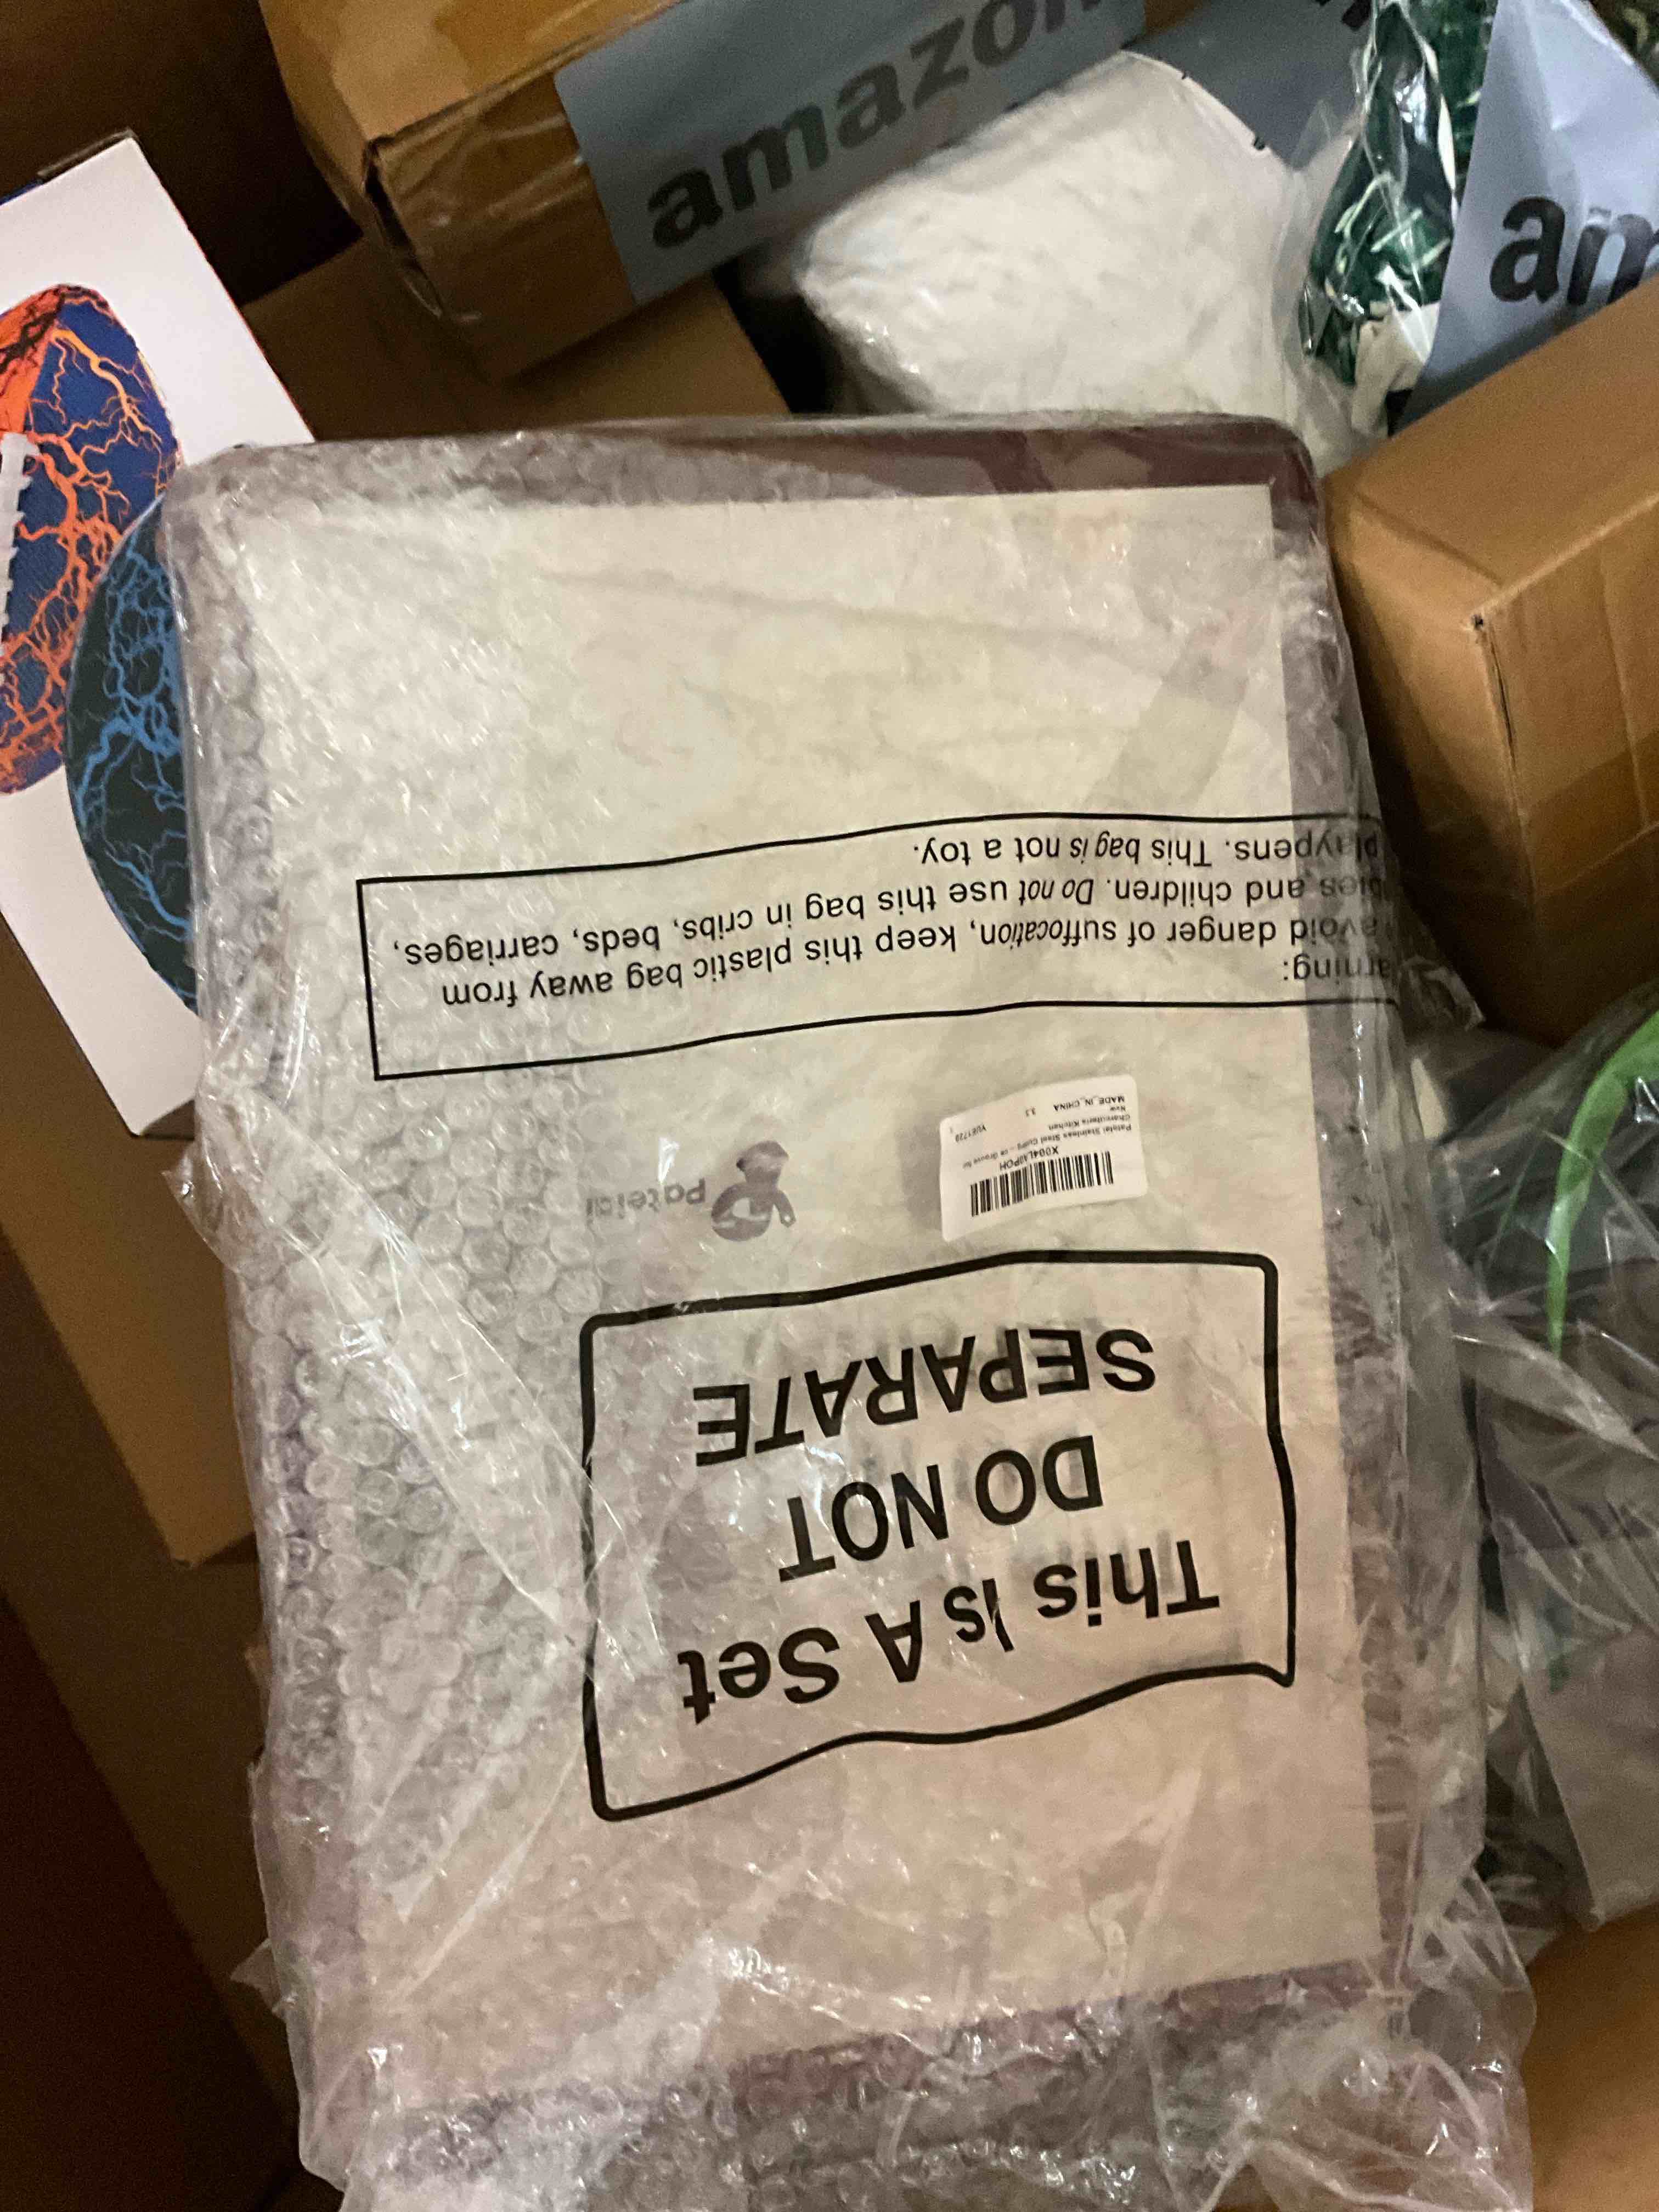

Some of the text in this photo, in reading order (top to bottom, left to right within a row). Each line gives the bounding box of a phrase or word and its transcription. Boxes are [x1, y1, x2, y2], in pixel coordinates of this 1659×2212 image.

[913, 837, 972, 867] toy.
[983, 839, 1002, 860] a
[1014, 837, 1060, 864] not
[1069, 838, 1089, 865] is
[1094, 830, 1140, 865] bag
[1151, 839, 1212, 868] This
[805, 893, 865, 920] bag
[877, 885, 936, 916] this
[949, 879, 1008, 904] use
[1018, 879, 1056, 906] not
[1061, 878, 1094, 906] Do
[1106, 879, 1232, 909] children.
[1245, 878, 1306, 908] and
[673, 909, 754, 941] cribs,
[766, 903, 792, 929] in
[393, 934, 559, 967] carriages,
[572, 926, 660, 958] beds,
[442, 915, 1379, 1008] avoid danger of suffocation, keep this plastic bag away from
[1283, 953, 1391, 988] arning:
[1040, 1133, 1061, 1144] Steel
[692, 1328, 1156, 1468] SEPARATE
[777, 1435, 1103, 1583] DO NOT
[676, 1540, 1220, 1725] This Is A Set
